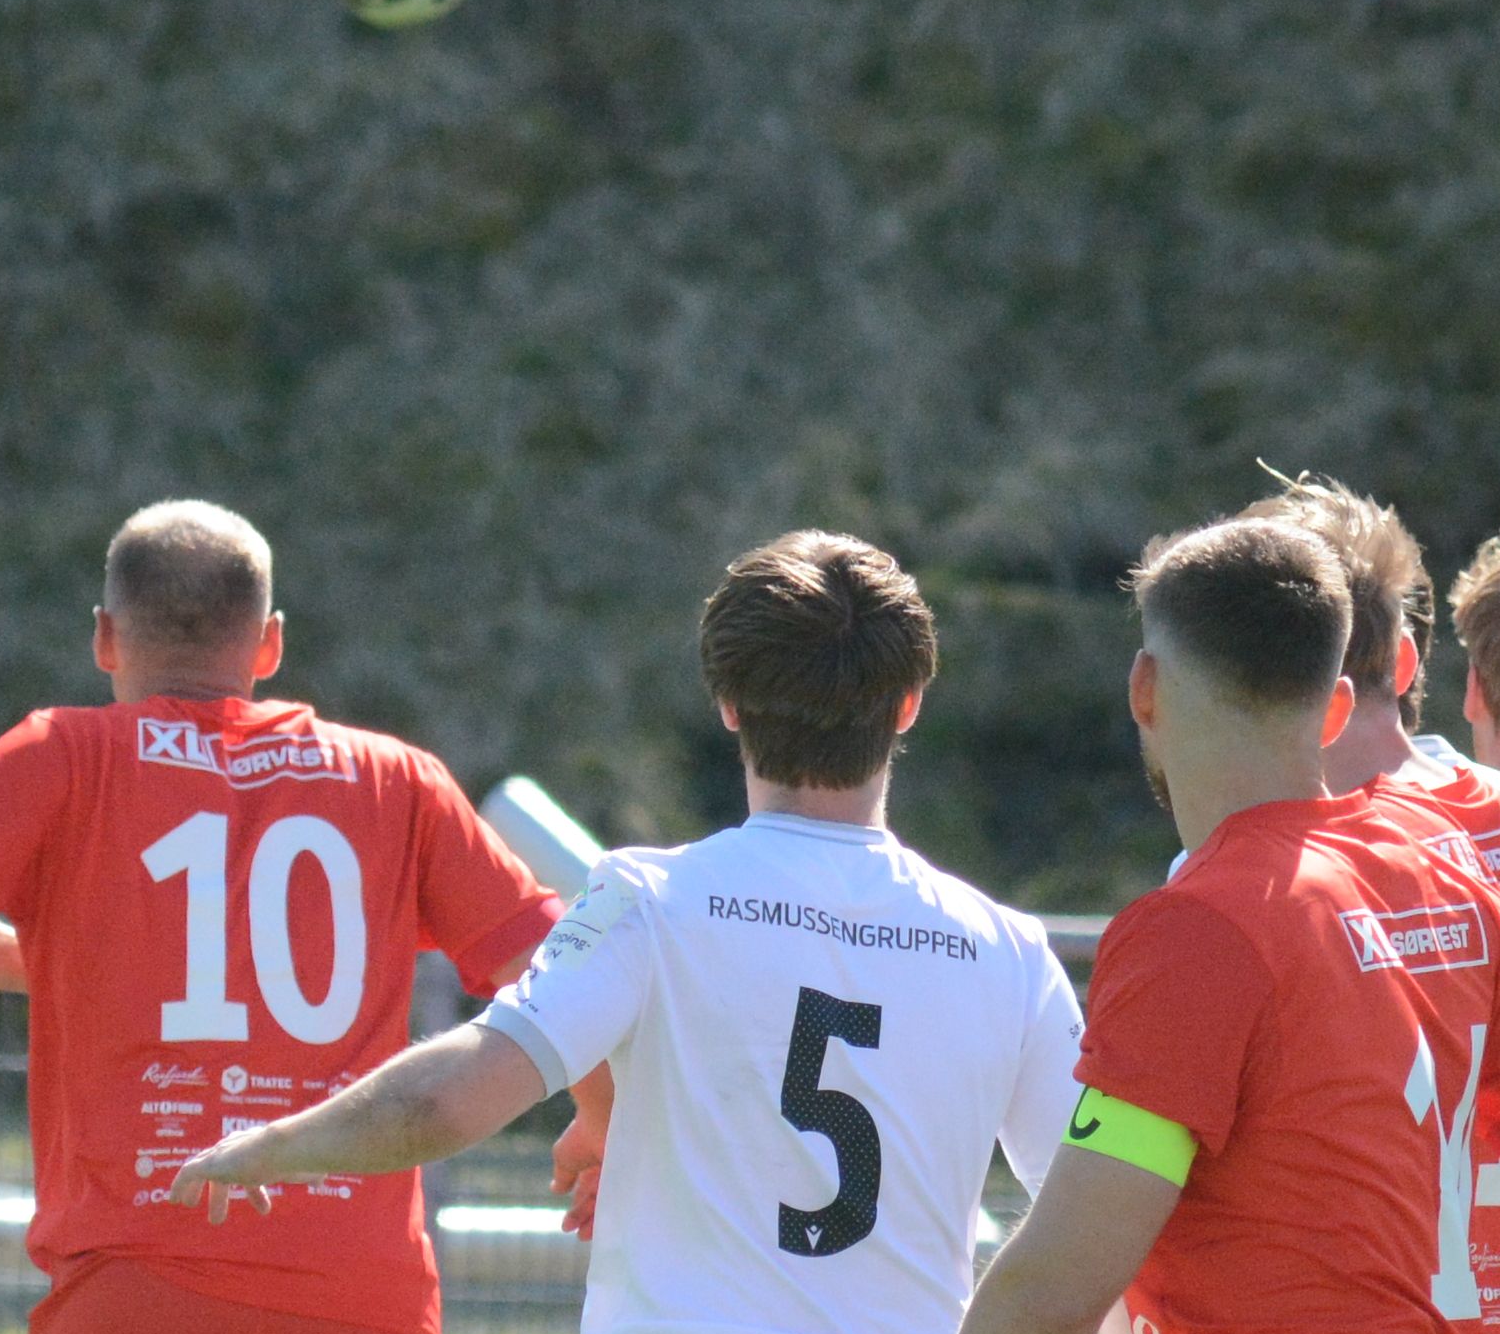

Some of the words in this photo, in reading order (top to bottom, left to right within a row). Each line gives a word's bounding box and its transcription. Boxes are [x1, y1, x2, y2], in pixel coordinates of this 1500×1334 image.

[146, 723, 209, 765] XL
[229, 744, 335, 776] ØRVEST
[141, 811, 367, 1045] 10
[709, 895, 978, 962] RASMUSSENGRUPPEN
[1389, 922, 1470, 957] SØREST
[779, 986, 882, 1258] 5
